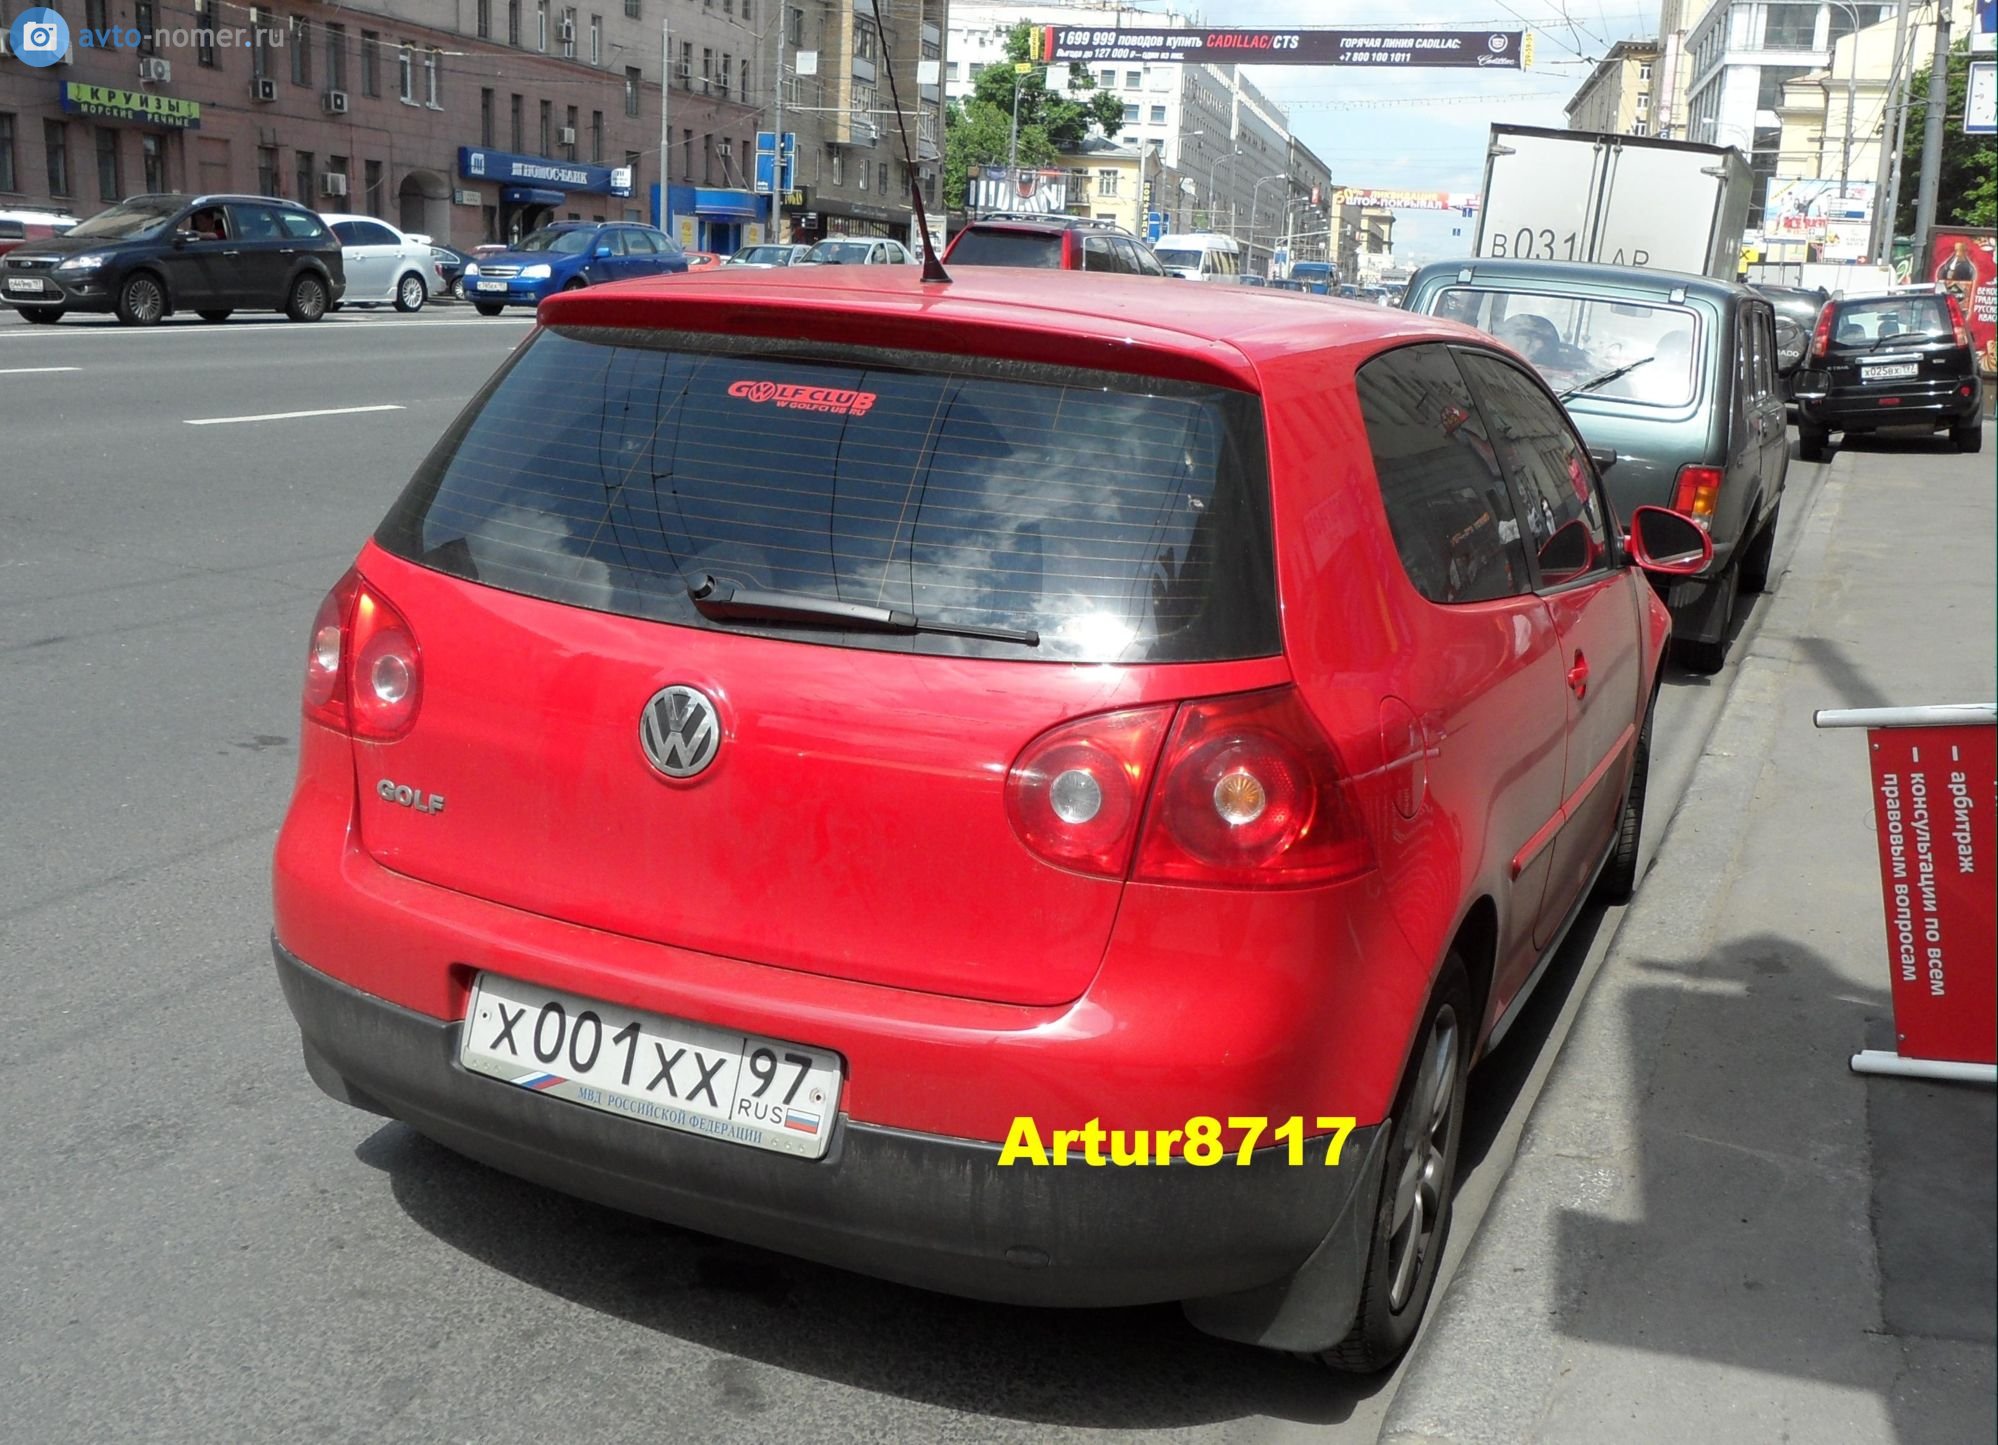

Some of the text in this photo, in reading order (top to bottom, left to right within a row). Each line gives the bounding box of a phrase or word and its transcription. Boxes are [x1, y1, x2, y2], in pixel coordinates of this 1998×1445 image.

[1092, 32, 1116, 46] 999
[1117, 35, 1164, 48] поводов
[1165, 36, 1203, 50] купить
[1206, 34, 1299, 49] CADILLAC/CTS
[1094, 48, 1111, 59] 127
[1111, 48, 1130, 59] 000
[1339, 37, 1382, 48] ГОРЯЧАЯ
[1382, 38, 1414, 48] ЛИНИЯ
[1339, 53, 1411, 62] +7 800 100 1011
[90, 87, 180, 113] КРУИЗЫ
[80, 103, 190, 128] МОРСКИЕ РЕЧНЫЕ
[1345, 196, 1442, 209] ШТОР-ПОКРЫВАЛ
[377, 779, 445, 815] GOLF
[1948, 771, 1974, 873] арбитраж
[1910, 772, 1937, 912] консультации
[1881, 773, 1917, 981] правовым вопросам
[1924, 917, 1941, 942] по
[1927, 947, 1945, 996] всем
[489, 1001, 813, 1108] Х001ХХ 97
[577, 1086, 763, 1144] МВД РОССИЙСКОЙ ФЕДЕРАЦИИ
[737, 1098, 782, 1125] RUS
